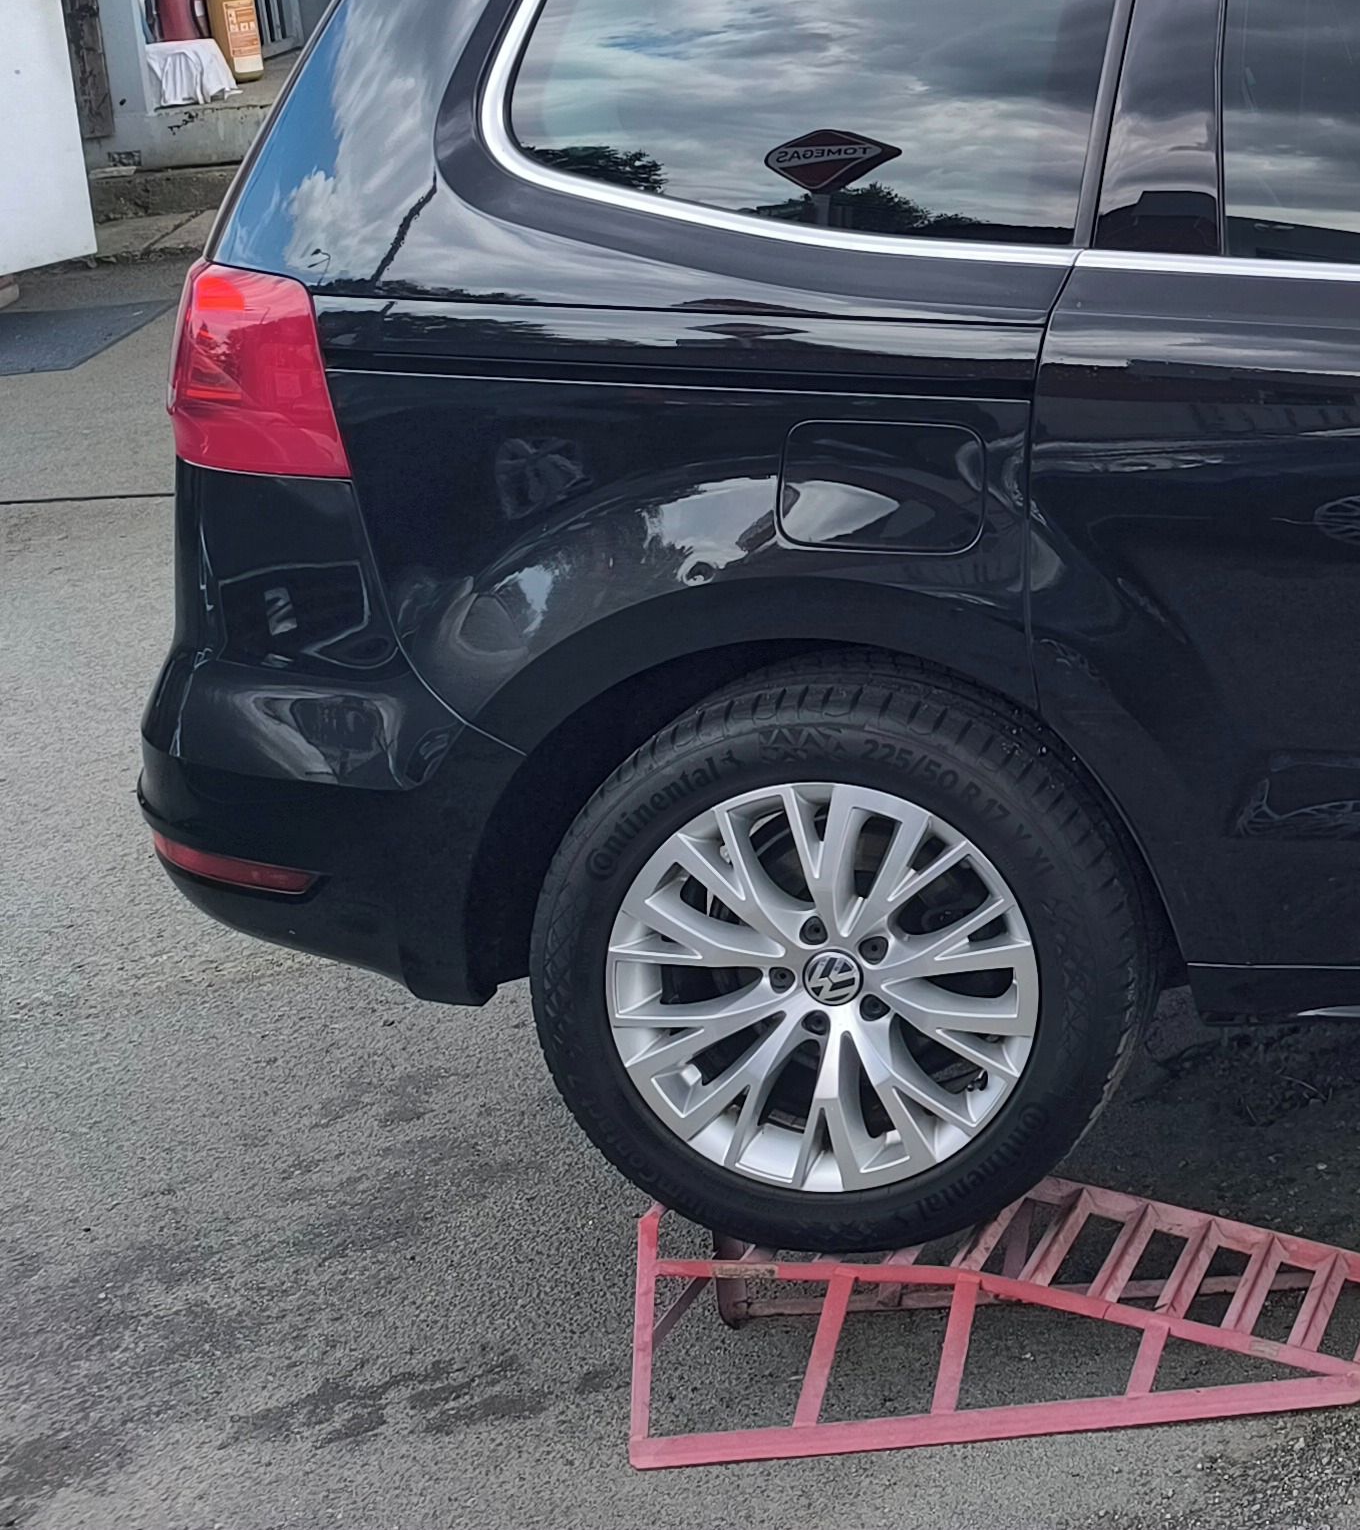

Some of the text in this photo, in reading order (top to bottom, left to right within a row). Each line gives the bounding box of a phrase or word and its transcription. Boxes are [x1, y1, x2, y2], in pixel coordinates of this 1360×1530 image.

[586, 757, 721, 881] Continental
[862, 739, 959, 789] 225/50
[961, 781, 982, 804] R
[980, 798, 1011, 820] 17
